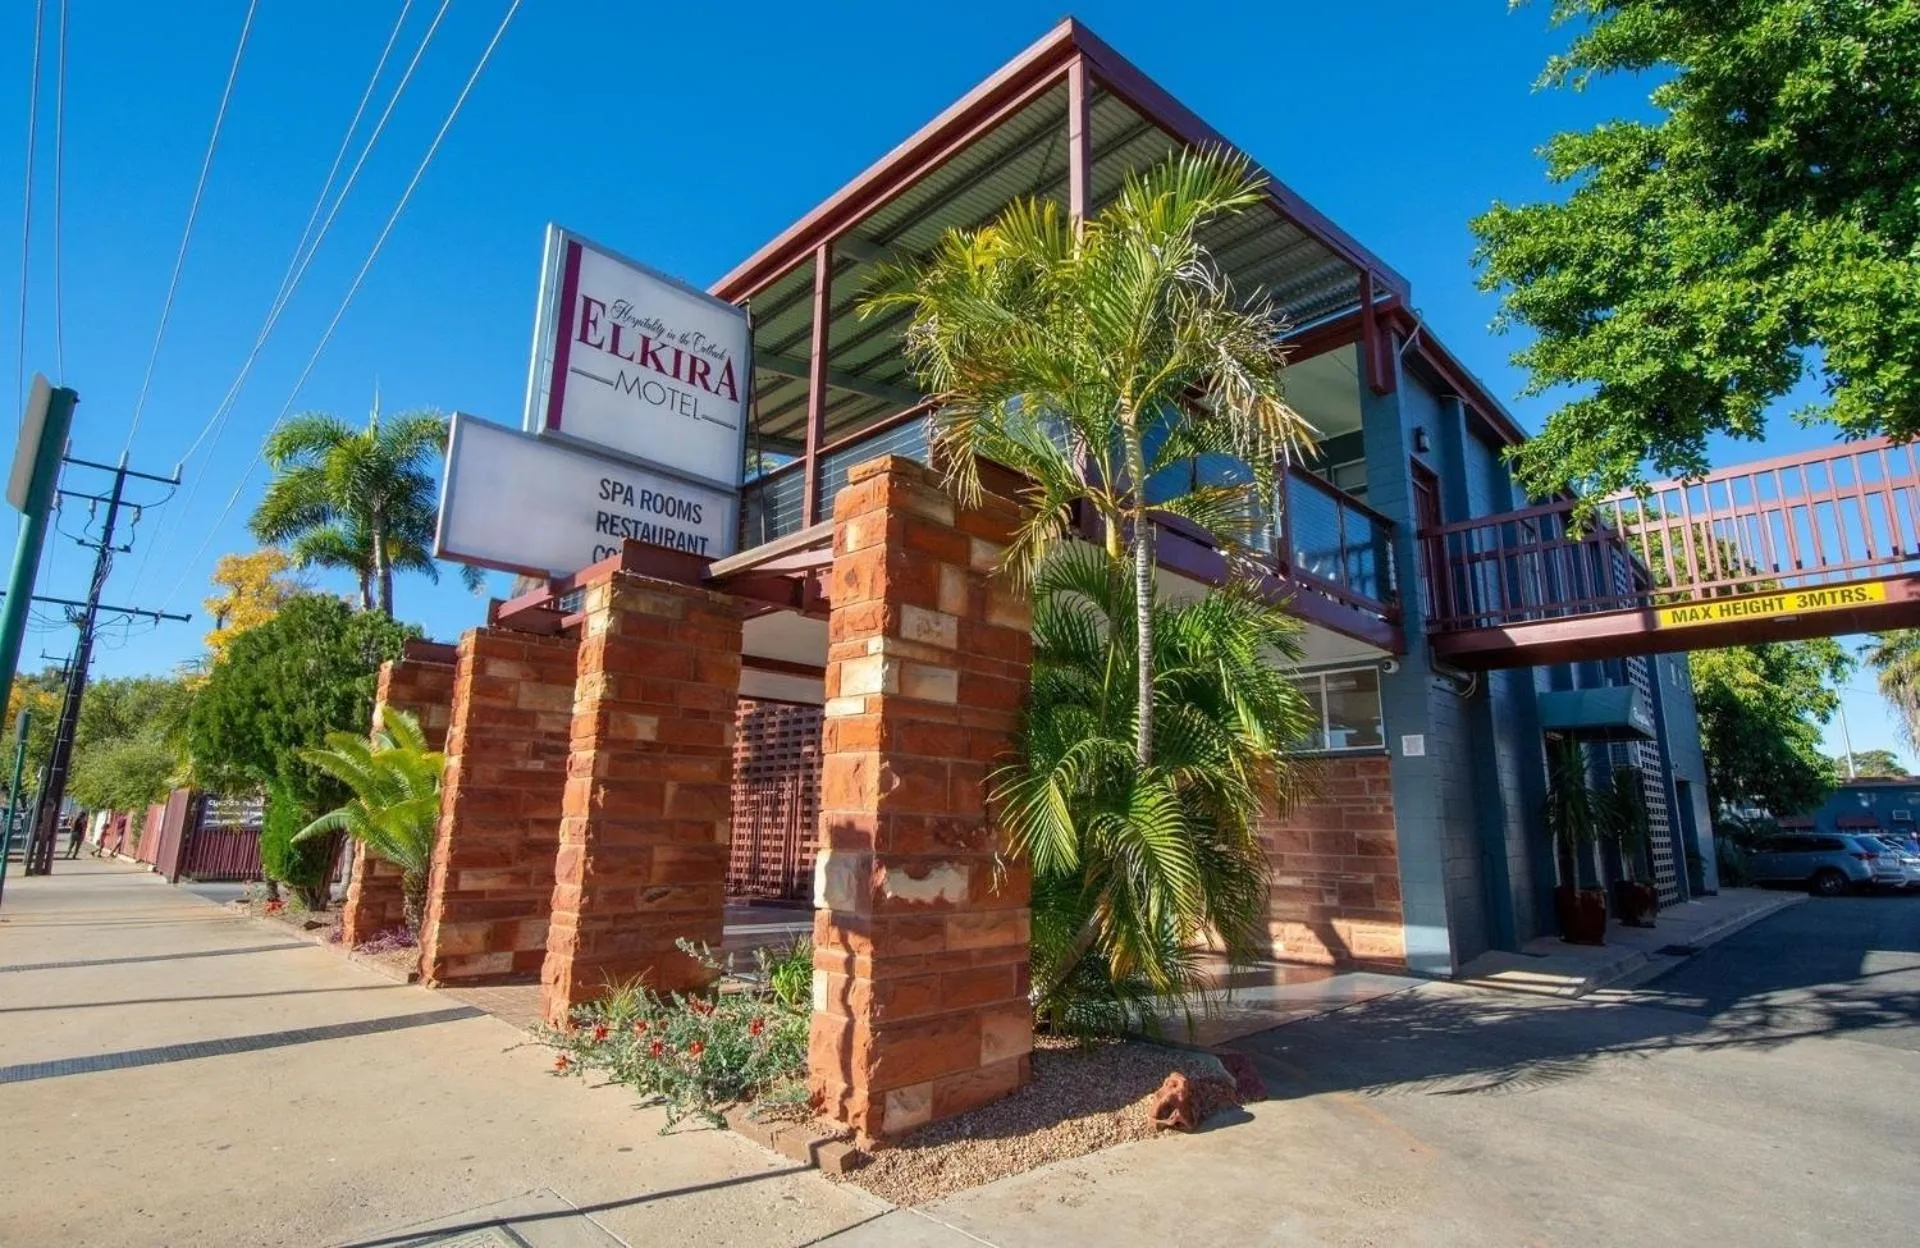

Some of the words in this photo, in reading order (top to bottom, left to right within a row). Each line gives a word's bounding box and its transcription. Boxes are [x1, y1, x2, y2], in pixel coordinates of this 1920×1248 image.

[611, 298, 665, 340] Hospitality
[666, 329, 676, 341] in
[679, 331, 691, 346] the
[576, 294, 739, 403] ELKIRA
[614, 370, 701, 420] MOTEL
[598, 478, 634, 507] SPA
[640, 489, 702, 524] ROOMS
[596, 511, 709, 556] RESTAURANT
[1671, 605, 1713, 625] MAX
[1719, 596, 1786, 618] HEIGHT
[1796, 586, 1874, 609] 3MTRS.
